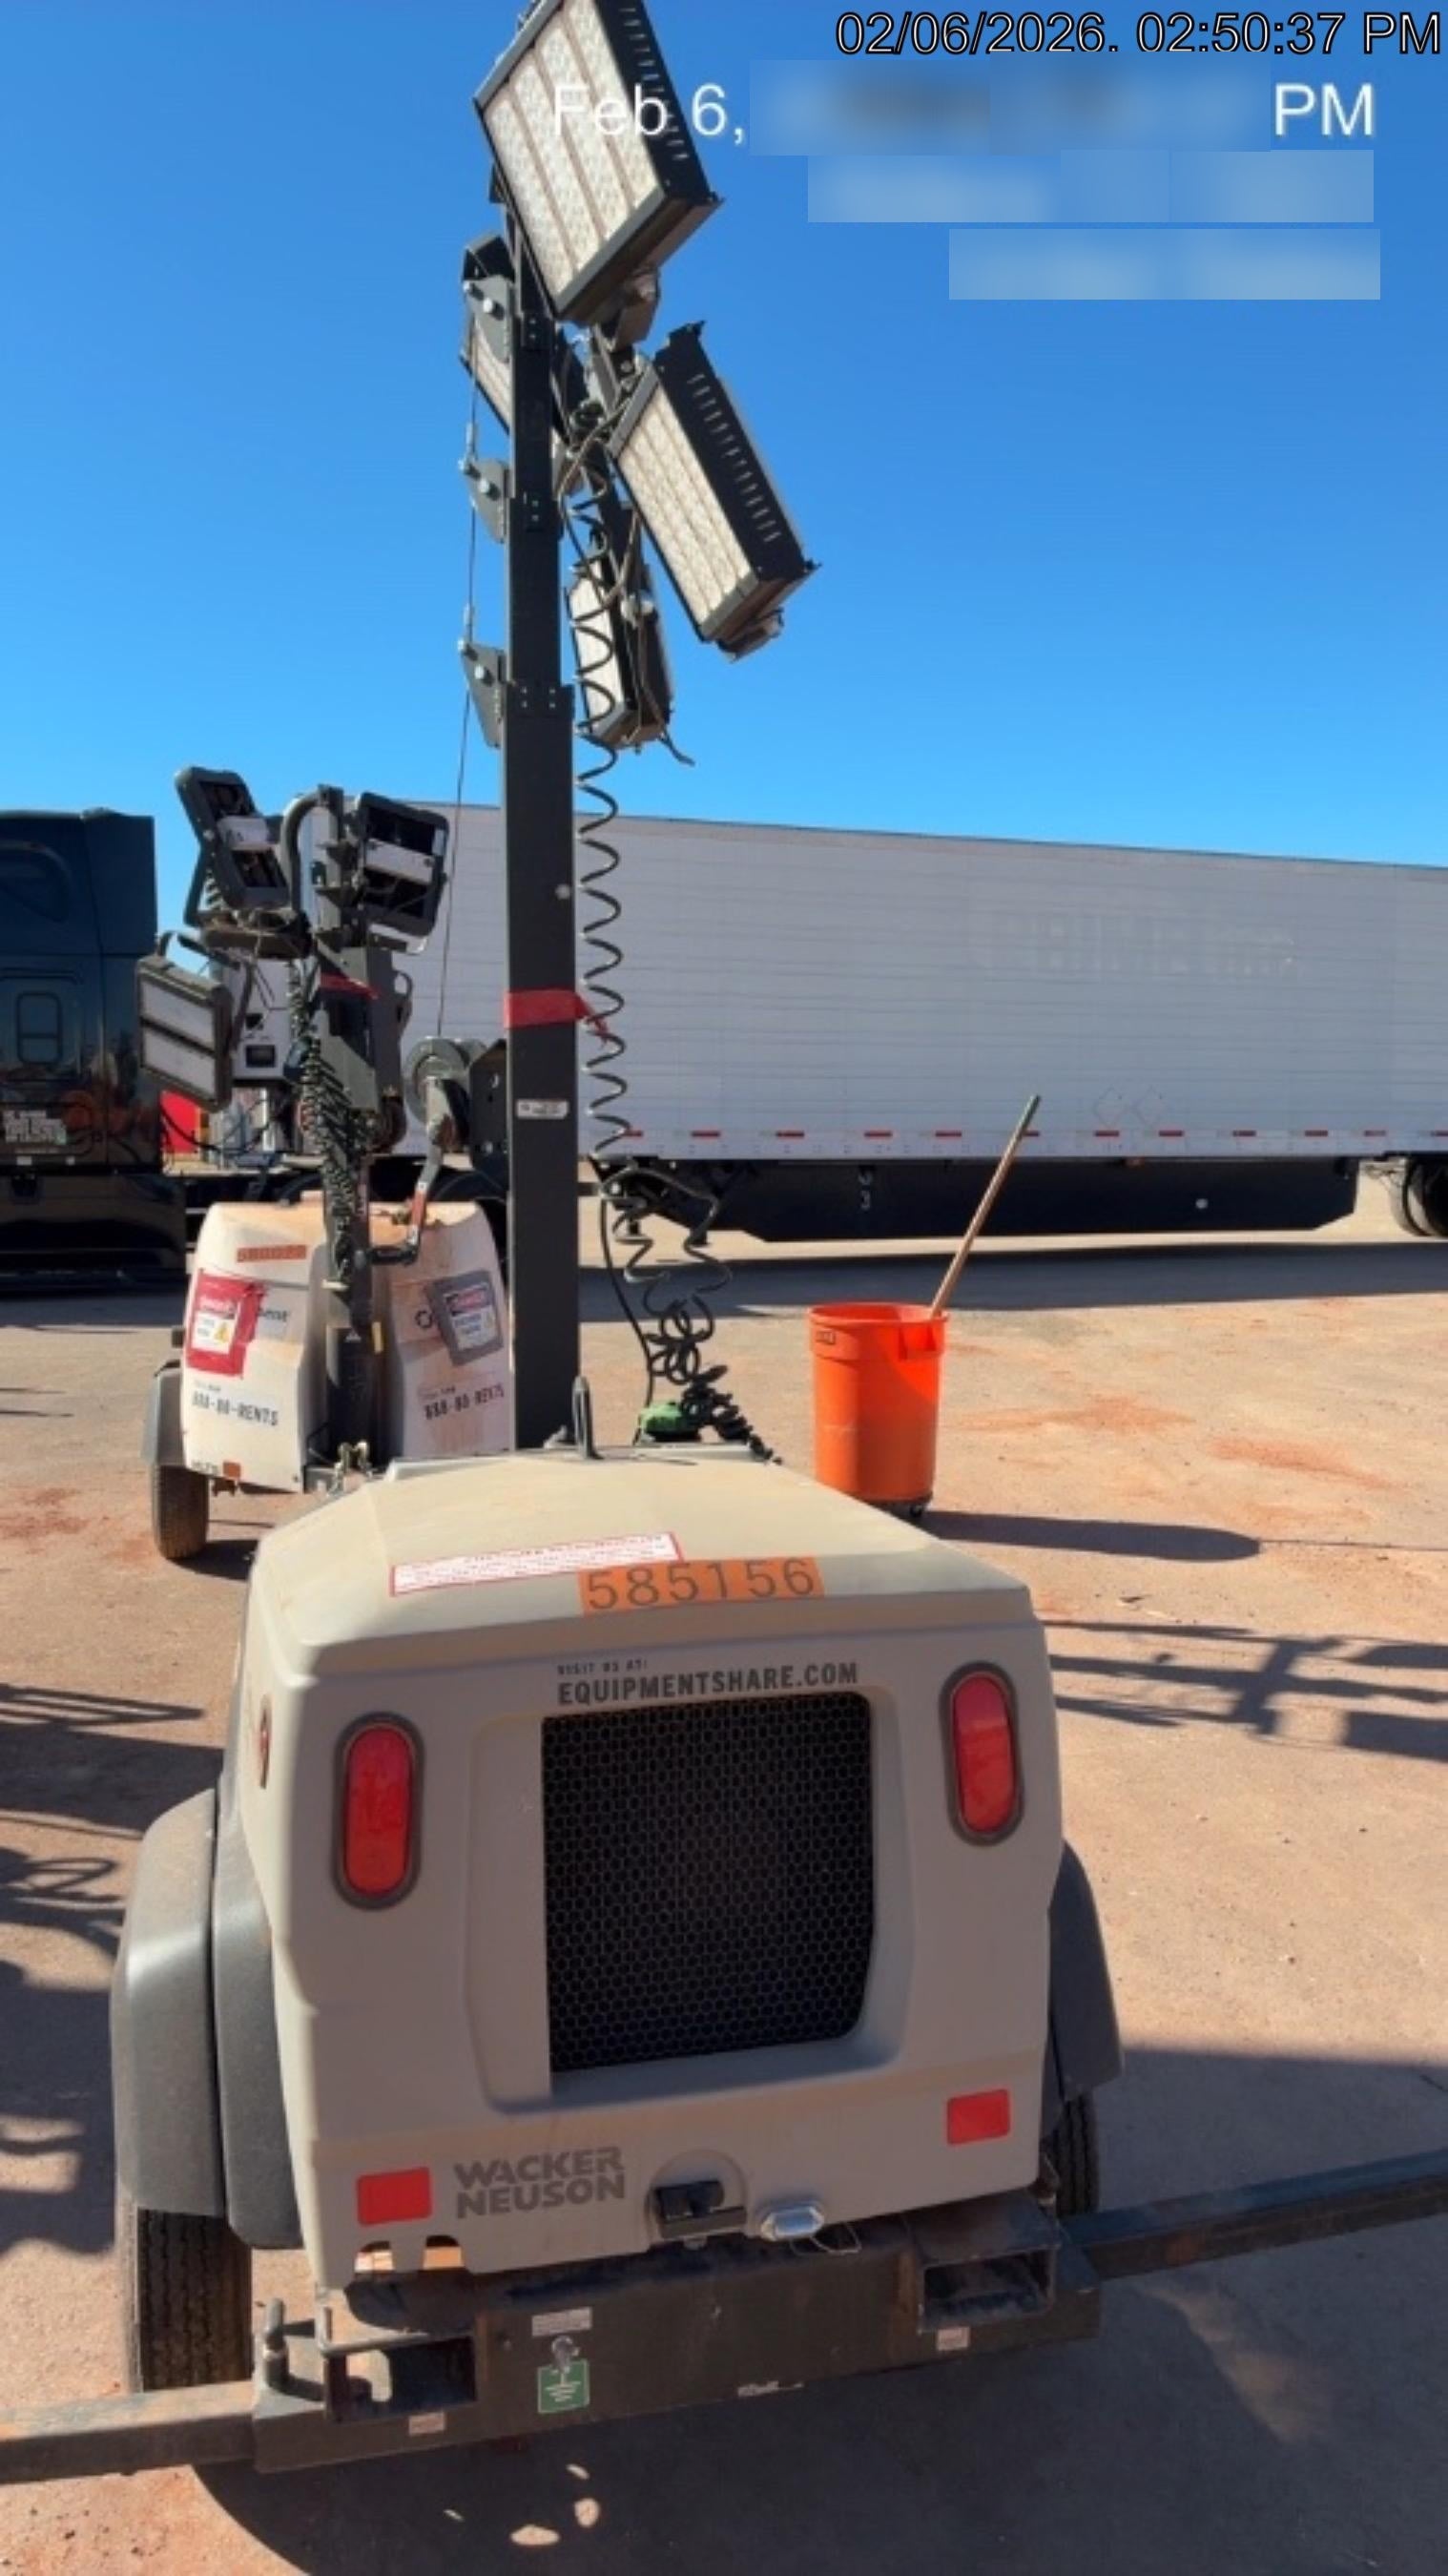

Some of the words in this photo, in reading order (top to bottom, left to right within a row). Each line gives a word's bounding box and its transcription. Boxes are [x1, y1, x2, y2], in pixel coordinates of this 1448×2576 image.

[588, 1558, 815, 1610] 585156
[558, 1663, 858, 1705] EQUIPMENTSHARE.COM
[454, 2147, 625, 2191] WACKER
[457, 2173, 625, 2219] NEUSON
